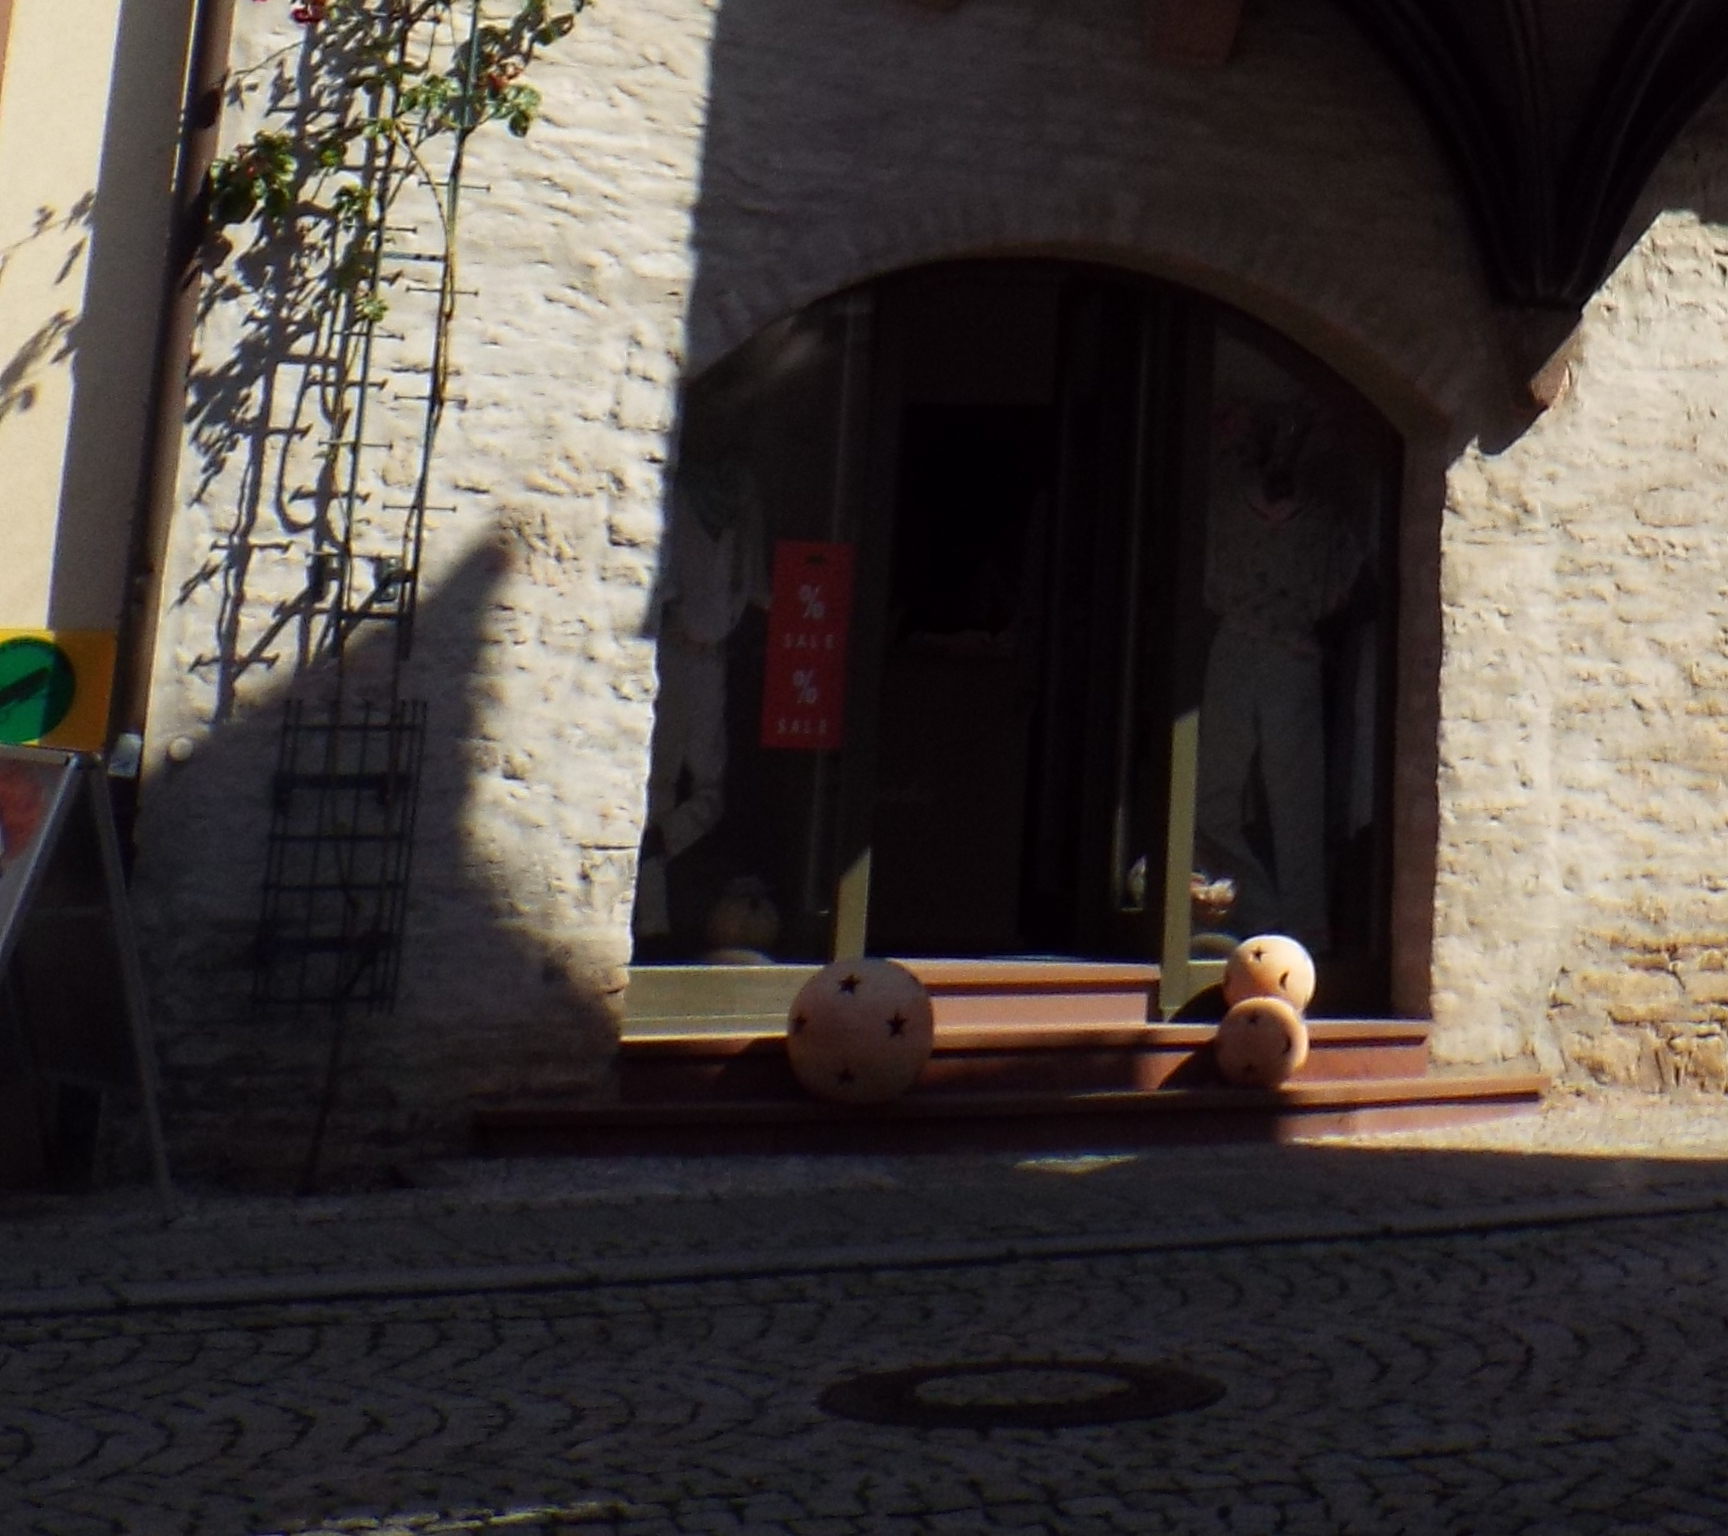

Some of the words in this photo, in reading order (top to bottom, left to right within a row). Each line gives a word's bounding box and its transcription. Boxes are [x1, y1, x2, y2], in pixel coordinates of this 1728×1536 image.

[798, 584, 826, 619] %
[783, 633, 835, 650] SALE
[792, 669, 819, 705] %
[776, 718, 828, 736] SALE
